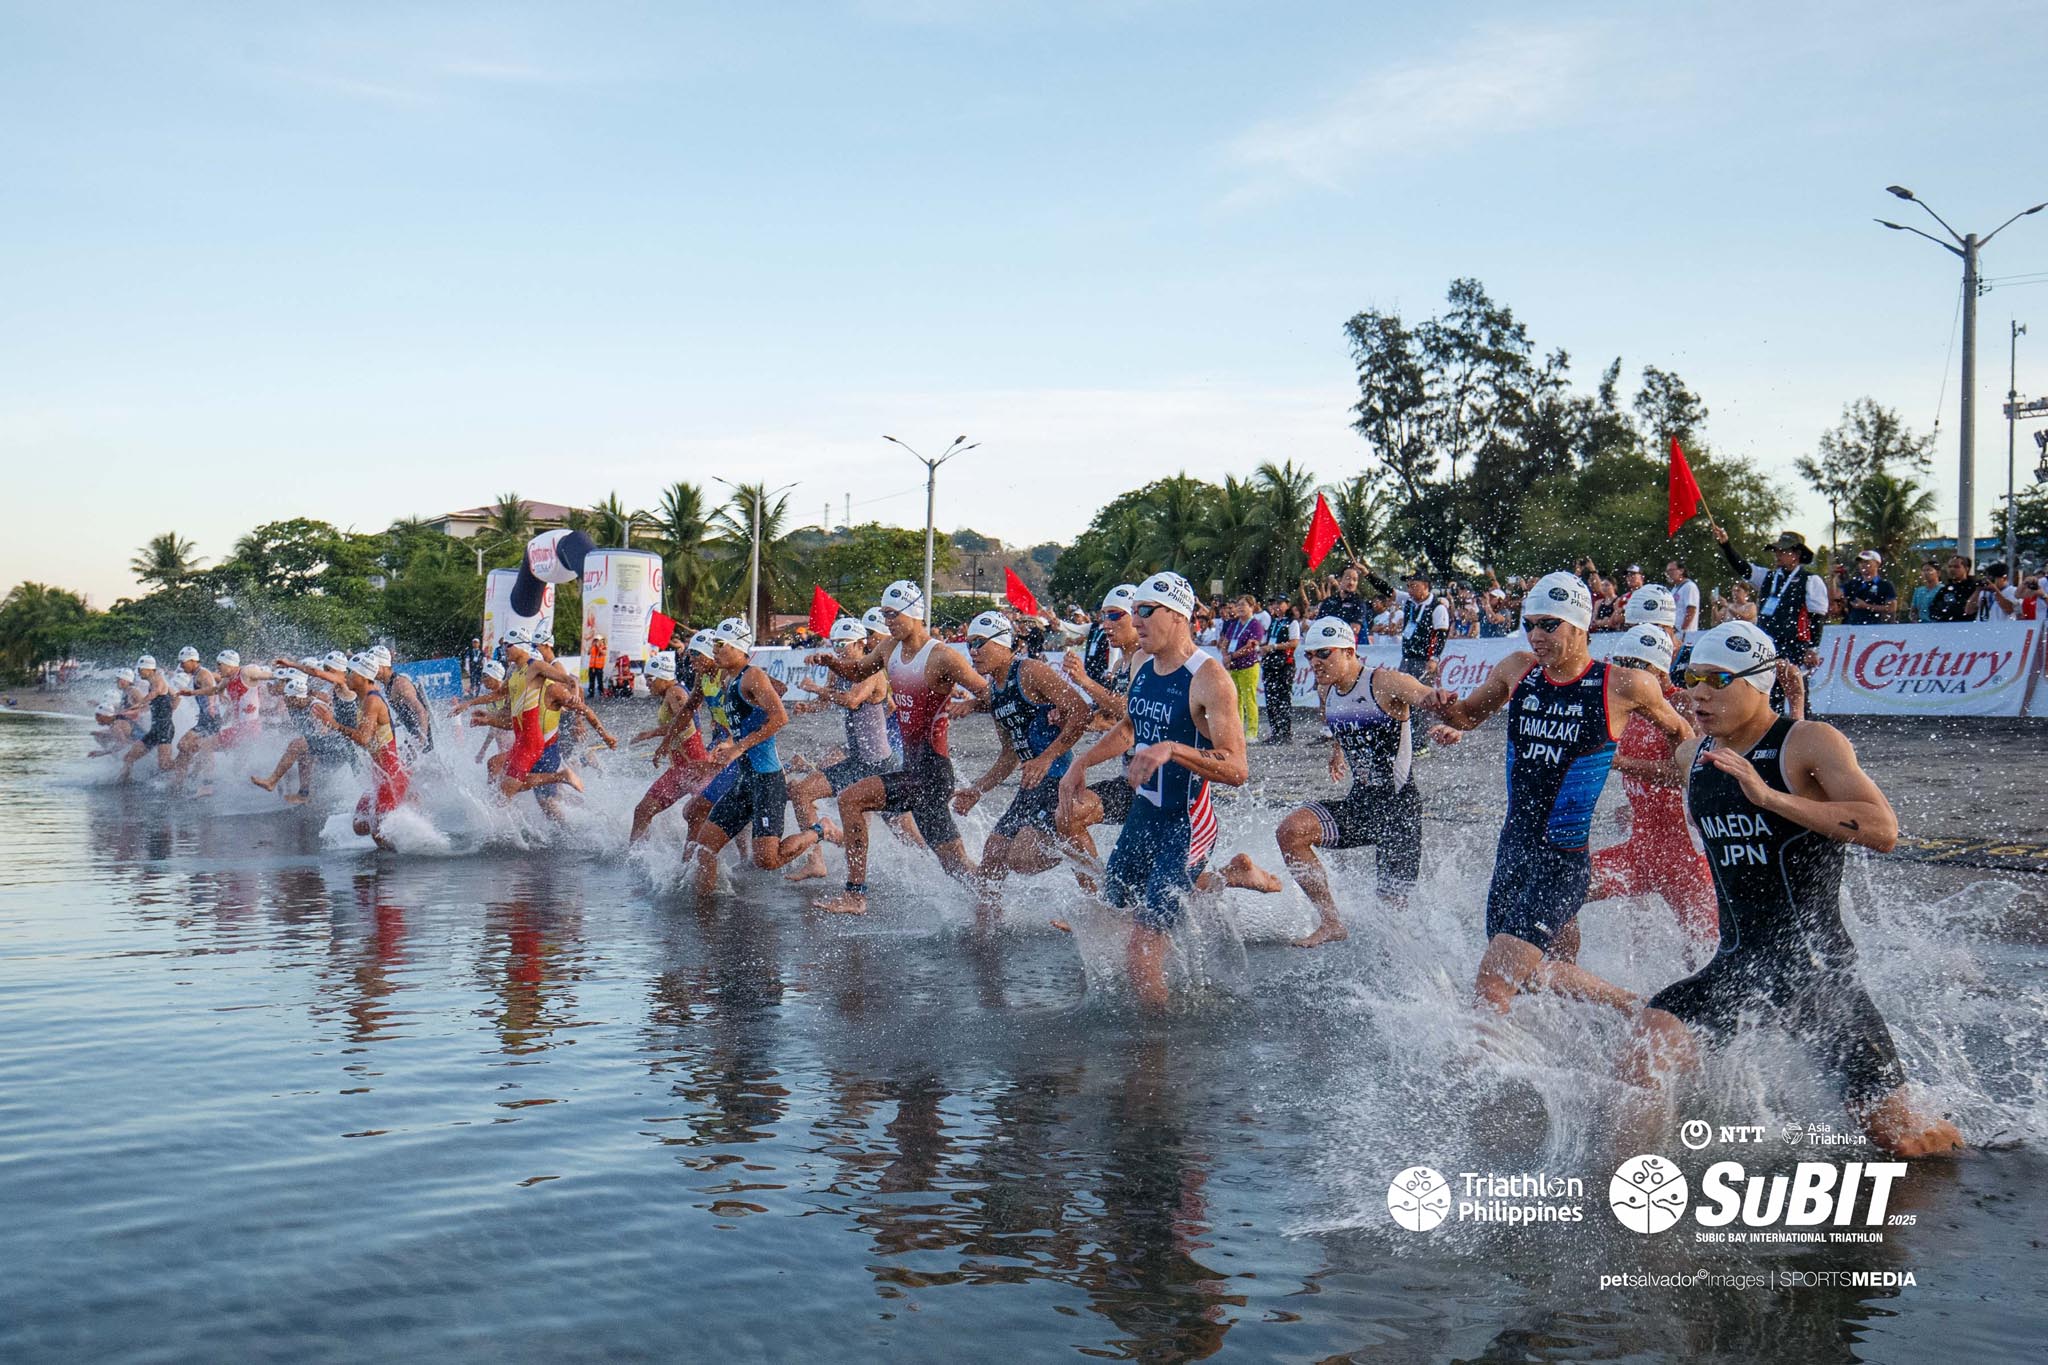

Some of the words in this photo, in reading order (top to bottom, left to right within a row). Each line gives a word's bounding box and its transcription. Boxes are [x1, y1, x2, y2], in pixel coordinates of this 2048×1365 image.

[1854, 639, 2013, 690] Century
[1897, 678, 1967, 694] TUNA
[1128, 696, 1173, 725] COHEN
[1134, 718, 1161, 743] USA
[1332, 720, 1360, 736] KIM
[1519, 715, 1581, 743] TAMAZAKI
[1522, 742, 1562, 765] JPN
[1700, 813, 1774, 840] MAEDA
[1720, 843, 1768, 867] JPN
